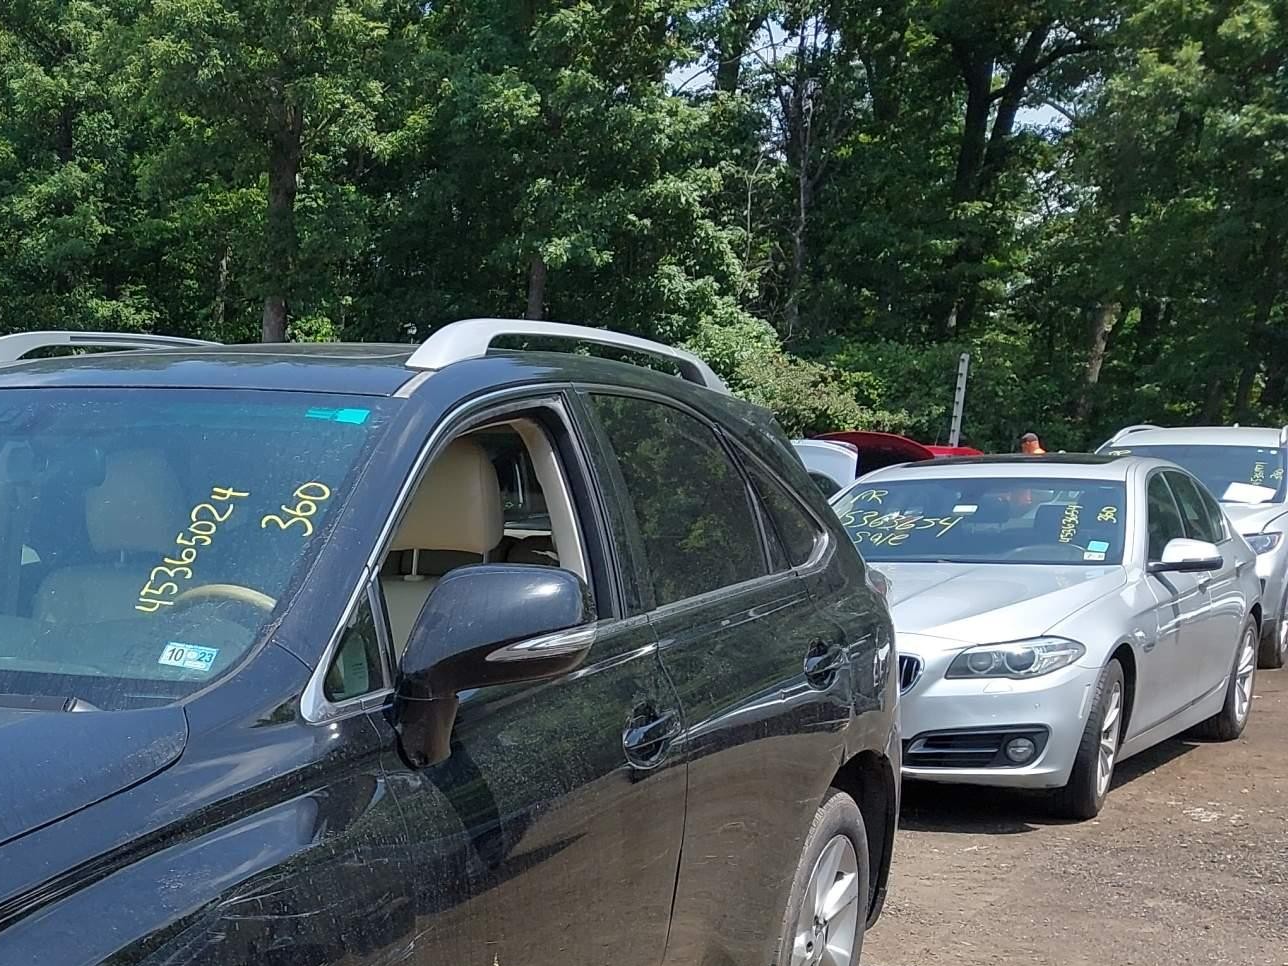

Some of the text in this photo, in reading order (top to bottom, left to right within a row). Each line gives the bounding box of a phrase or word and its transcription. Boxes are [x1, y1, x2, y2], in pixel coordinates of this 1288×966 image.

[262, 481, 330, 536] 360
[1096, 506, 1117, 523] 360
[136, 487, 250, 613] 45365024
[168, 647, 214, 663] 10 23
